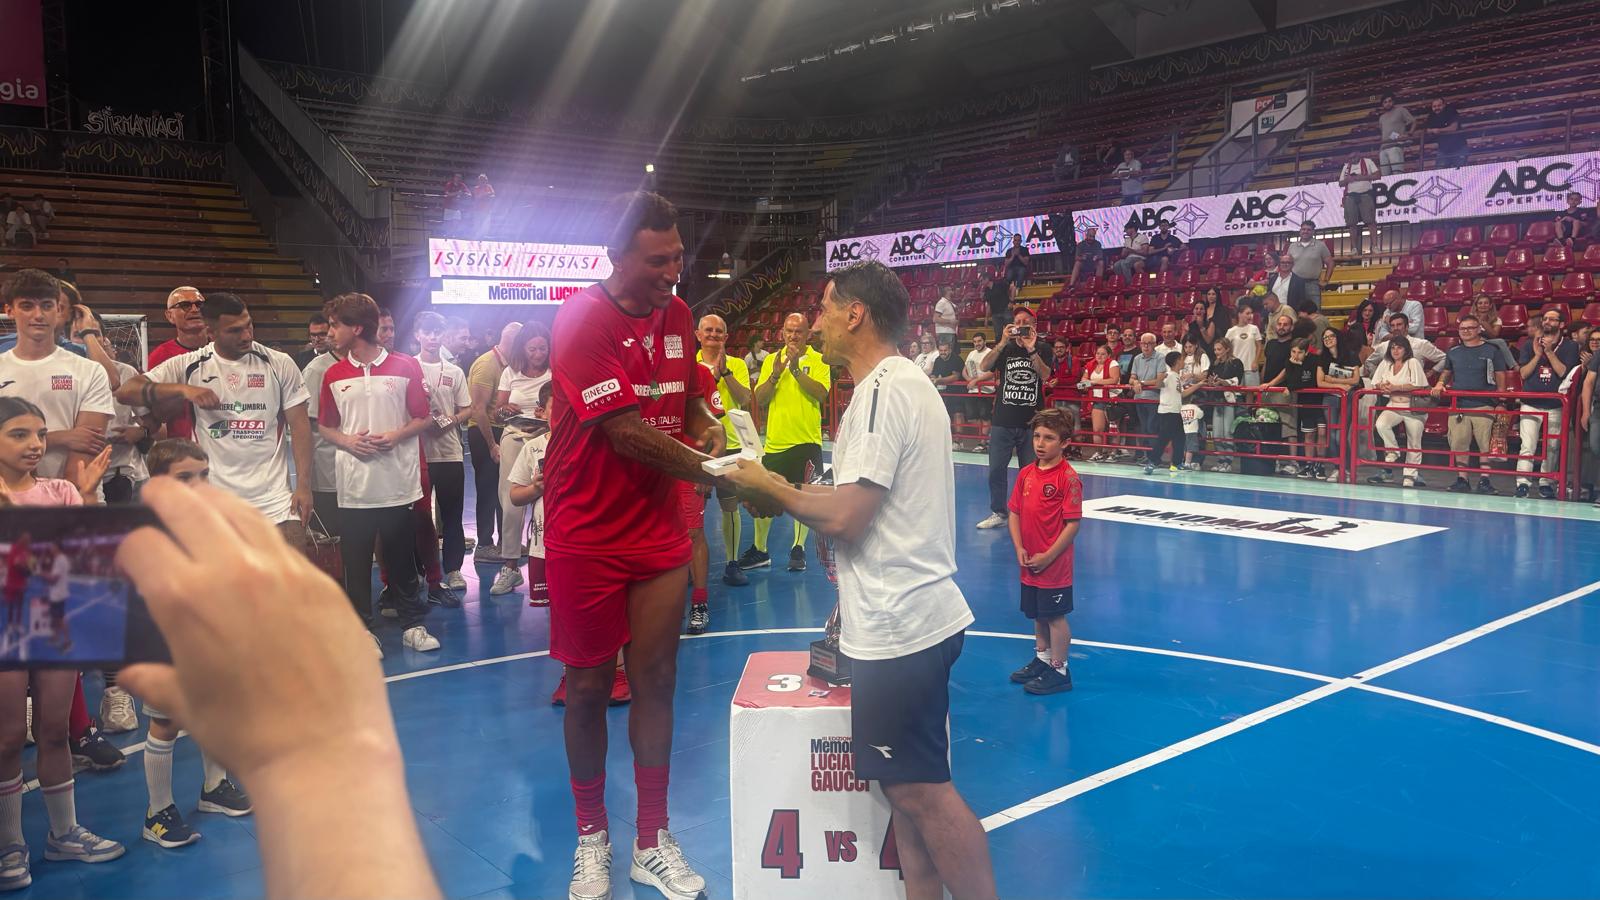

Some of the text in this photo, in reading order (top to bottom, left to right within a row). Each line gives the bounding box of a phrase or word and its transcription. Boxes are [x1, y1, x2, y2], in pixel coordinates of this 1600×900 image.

[1485, 162, 1575, 198] ABC
[1371, 178, 1418, 208] BC
[1485, 193, 1564, 207] COPERTUR
[1225, 193, 1288, 223] ABC
[1377, 207, 1418, 217] RTURE
[1124, 205, 1178, 233] ABC
[1225, 220, 1288, 231] COPERTURE
[957, 225, 997, 250] ABC
[1026, 220, 1054, 243] AB
[828, 242, 861, 263] ABC
[889, 234, 926, 257] ABC
[957, 247, 995, 256] COPERTUR
[1026, 241, 1056, 250] COPERT
[889, 255, 926, 263] COPERTURE
[488, 285, 583, 301] Memorial LUCI
[584, 382, 616, 401] FINECO
[659, 381, 685, 394] UMBRIA
[1005, 391, 1035, 401] MOLLO
[242, 402, 267, 411] UMBRIA
[230, 421, 264, 429] SUSA
[766, 674, 803, 693] 3
[810, 738, 854, 754] Memo
[810, 753, 856, 771] LUCIA
[761, 809, 803, 880] 4
